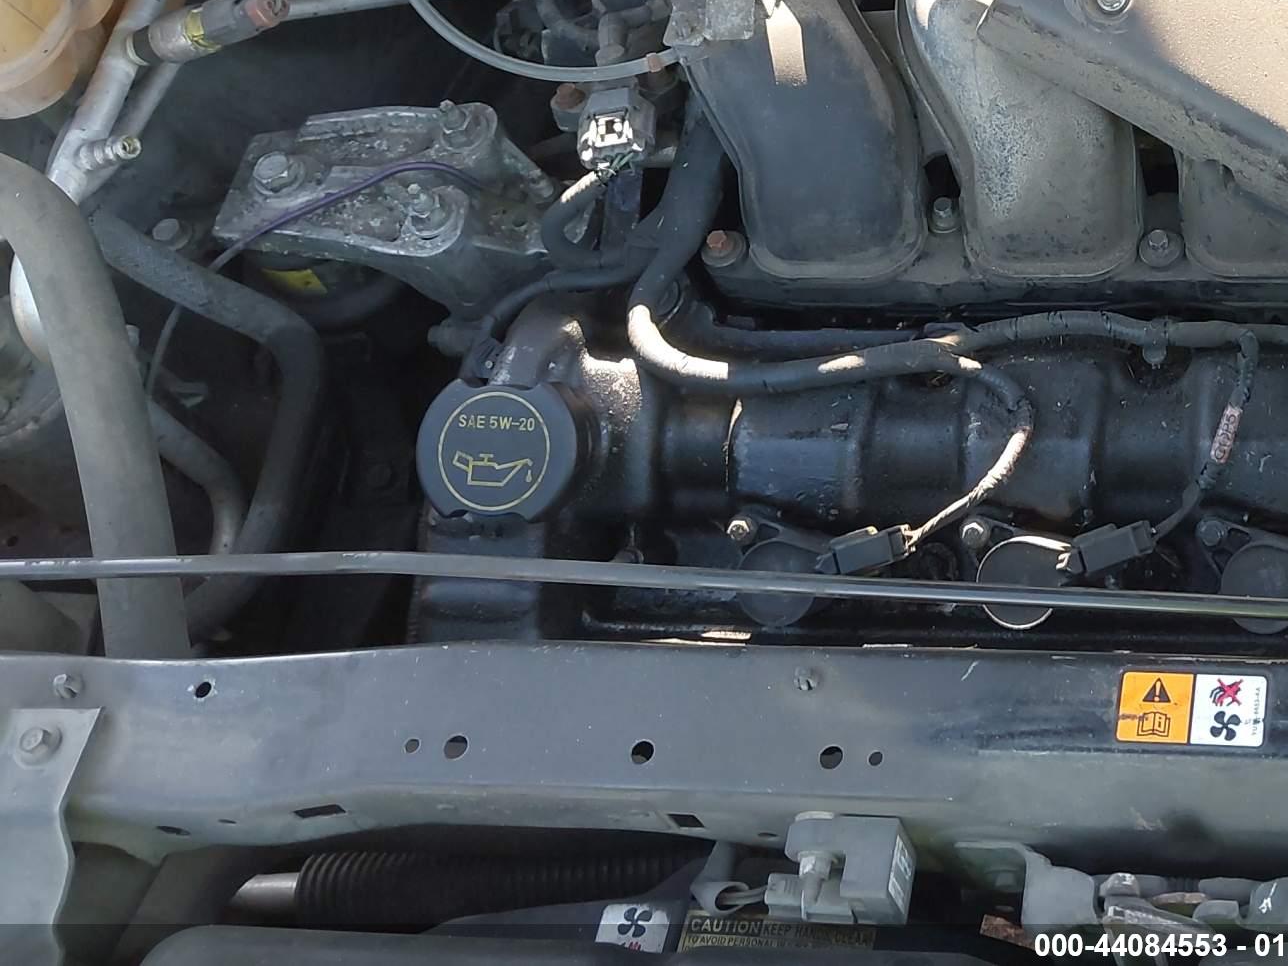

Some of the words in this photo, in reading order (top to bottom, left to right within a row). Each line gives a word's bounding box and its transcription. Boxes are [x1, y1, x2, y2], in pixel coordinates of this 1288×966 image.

[458, 414, 486, 429] SAE
[489, 415, 535, 431] 5W-20
[691, 918, 761, 933] CAUTION
[763, 921, 791, 935] KEEP
[699, 935, 726, 945] AVOID
